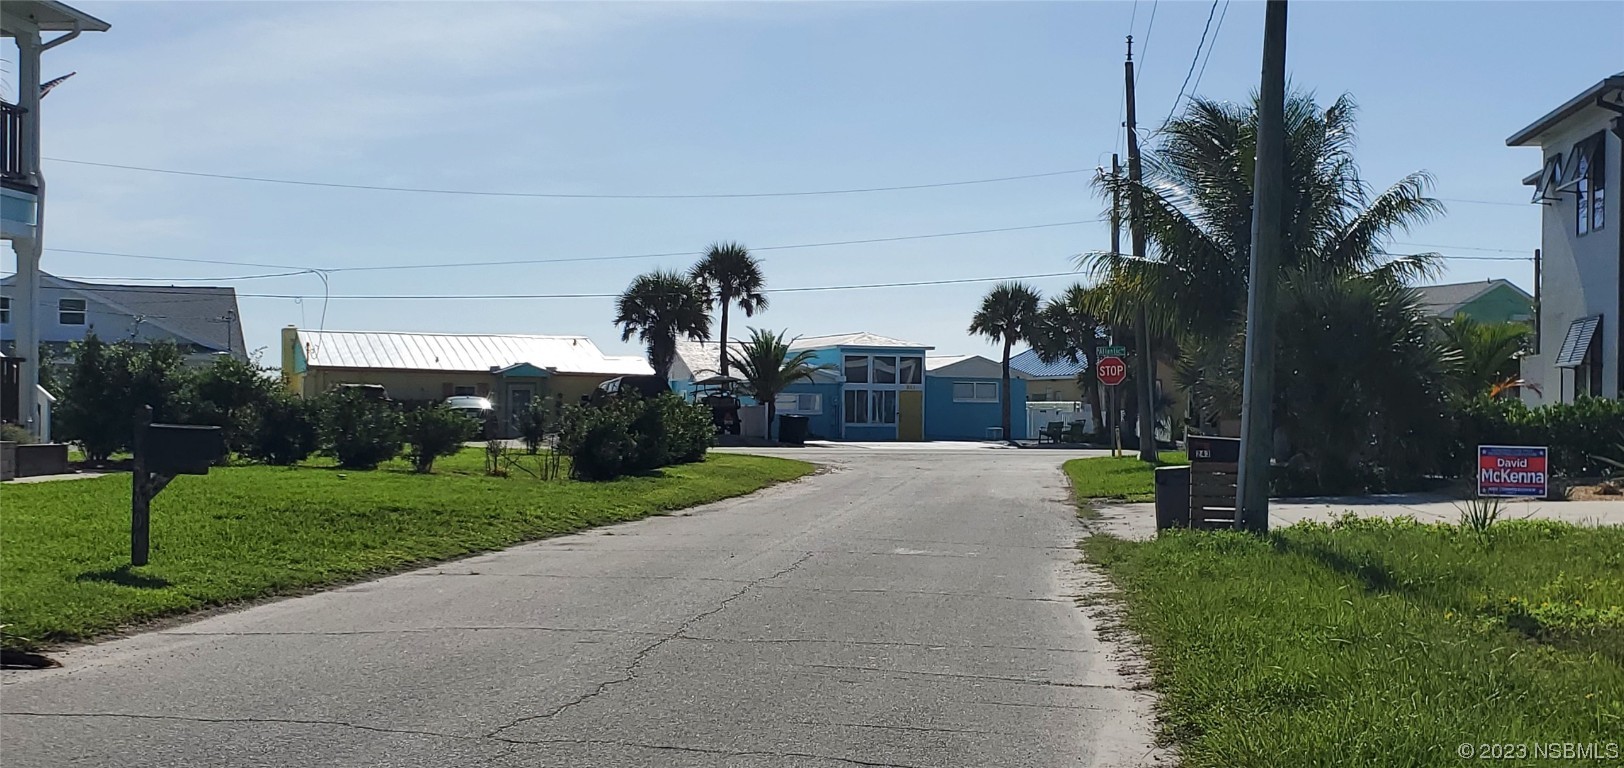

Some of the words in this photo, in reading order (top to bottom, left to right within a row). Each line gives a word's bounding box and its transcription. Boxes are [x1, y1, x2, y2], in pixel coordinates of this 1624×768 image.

[1098, 347, 1120, 355] Atlantic
[1099, 365, 1124, 377] STOP
[1497, 458, 1528, 468] David
[1481, 468, 1544, 484] McKenna
